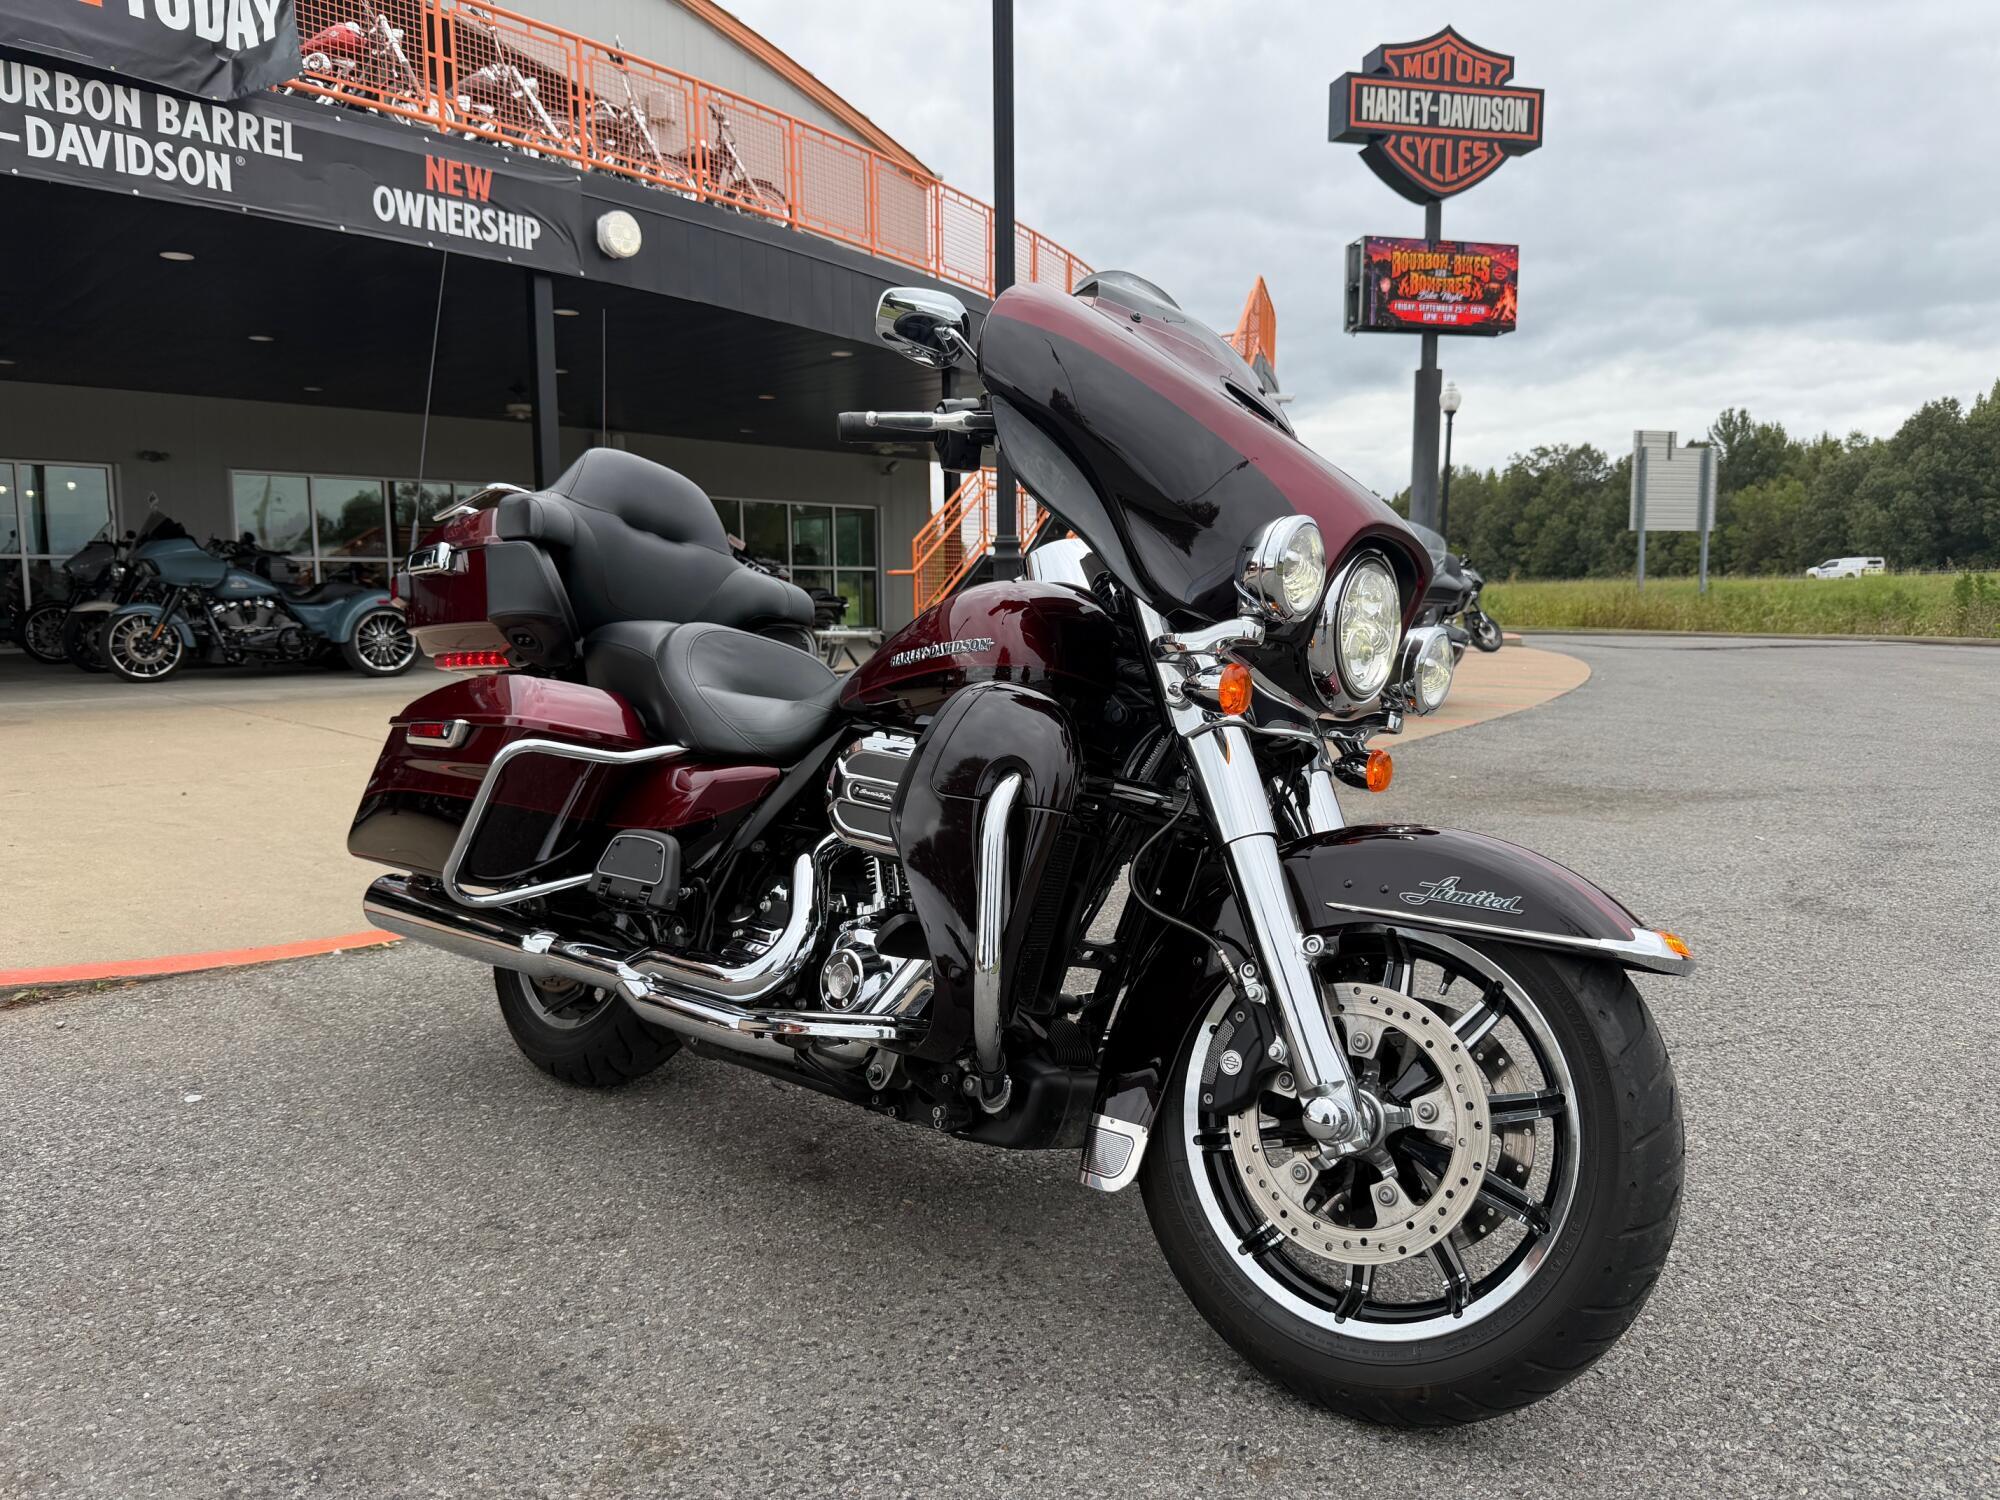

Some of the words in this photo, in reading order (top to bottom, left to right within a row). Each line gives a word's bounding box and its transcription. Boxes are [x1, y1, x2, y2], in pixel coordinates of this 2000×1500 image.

[1403, 43, 1492, 85] MOTOR
[156, 93, 303, 162] BARREL
[1361, 86, 1529, 133] HARLEY-DAVIDSON
[425, 154, 493, 203] NEW
[1400, 135, 1489, 182] CYCLES
[372, 184, 541, 250] OWNERSHIP
[1409, 271, 1472, 298] BONFIRES
[1454, 254, 1491, 282] BIKES
[1416, 290, 1438, 301] Bike
[1439, 290, 1463, 303] Night
[1418, 303, 1453, 313] SEPTEMBER
[1399, 876, 1524, 915] Limited
